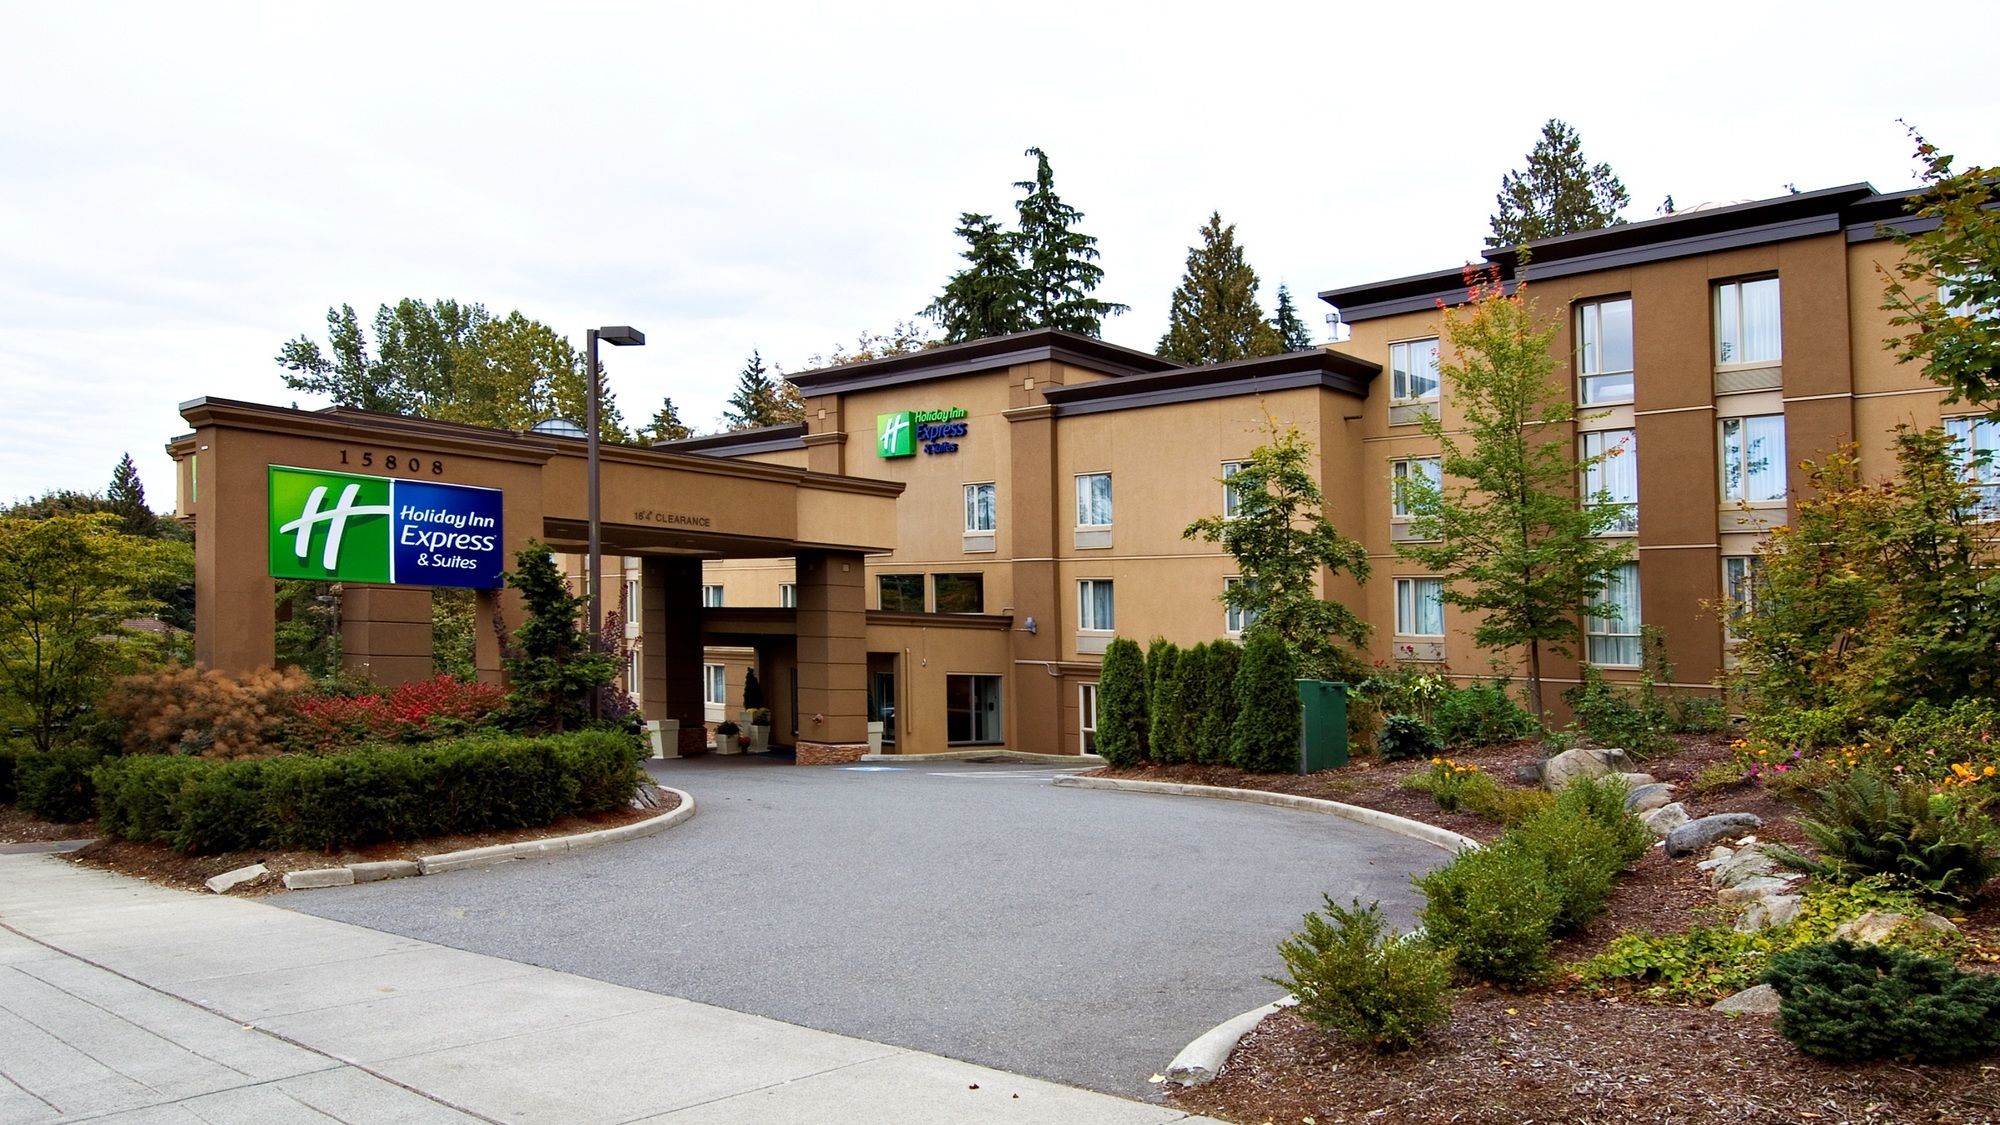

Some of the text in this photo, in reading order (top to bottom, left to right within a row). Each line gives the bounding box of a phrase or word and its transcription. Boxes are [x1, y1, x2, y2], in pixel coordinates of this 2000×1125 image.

[914, 407, 967, 423] Holiday Inn
[917, 423, 967, 442] Express
[931, 442, 959, 454] Suites
[339, 450, 444, 475] 15808
[400, 505, 495, 529] Holiday Inn
[655, 513, 711, 527] CLEARANCE
[400, 524, 495, 552] Express
[417, 553, 477, 569] & Suites
